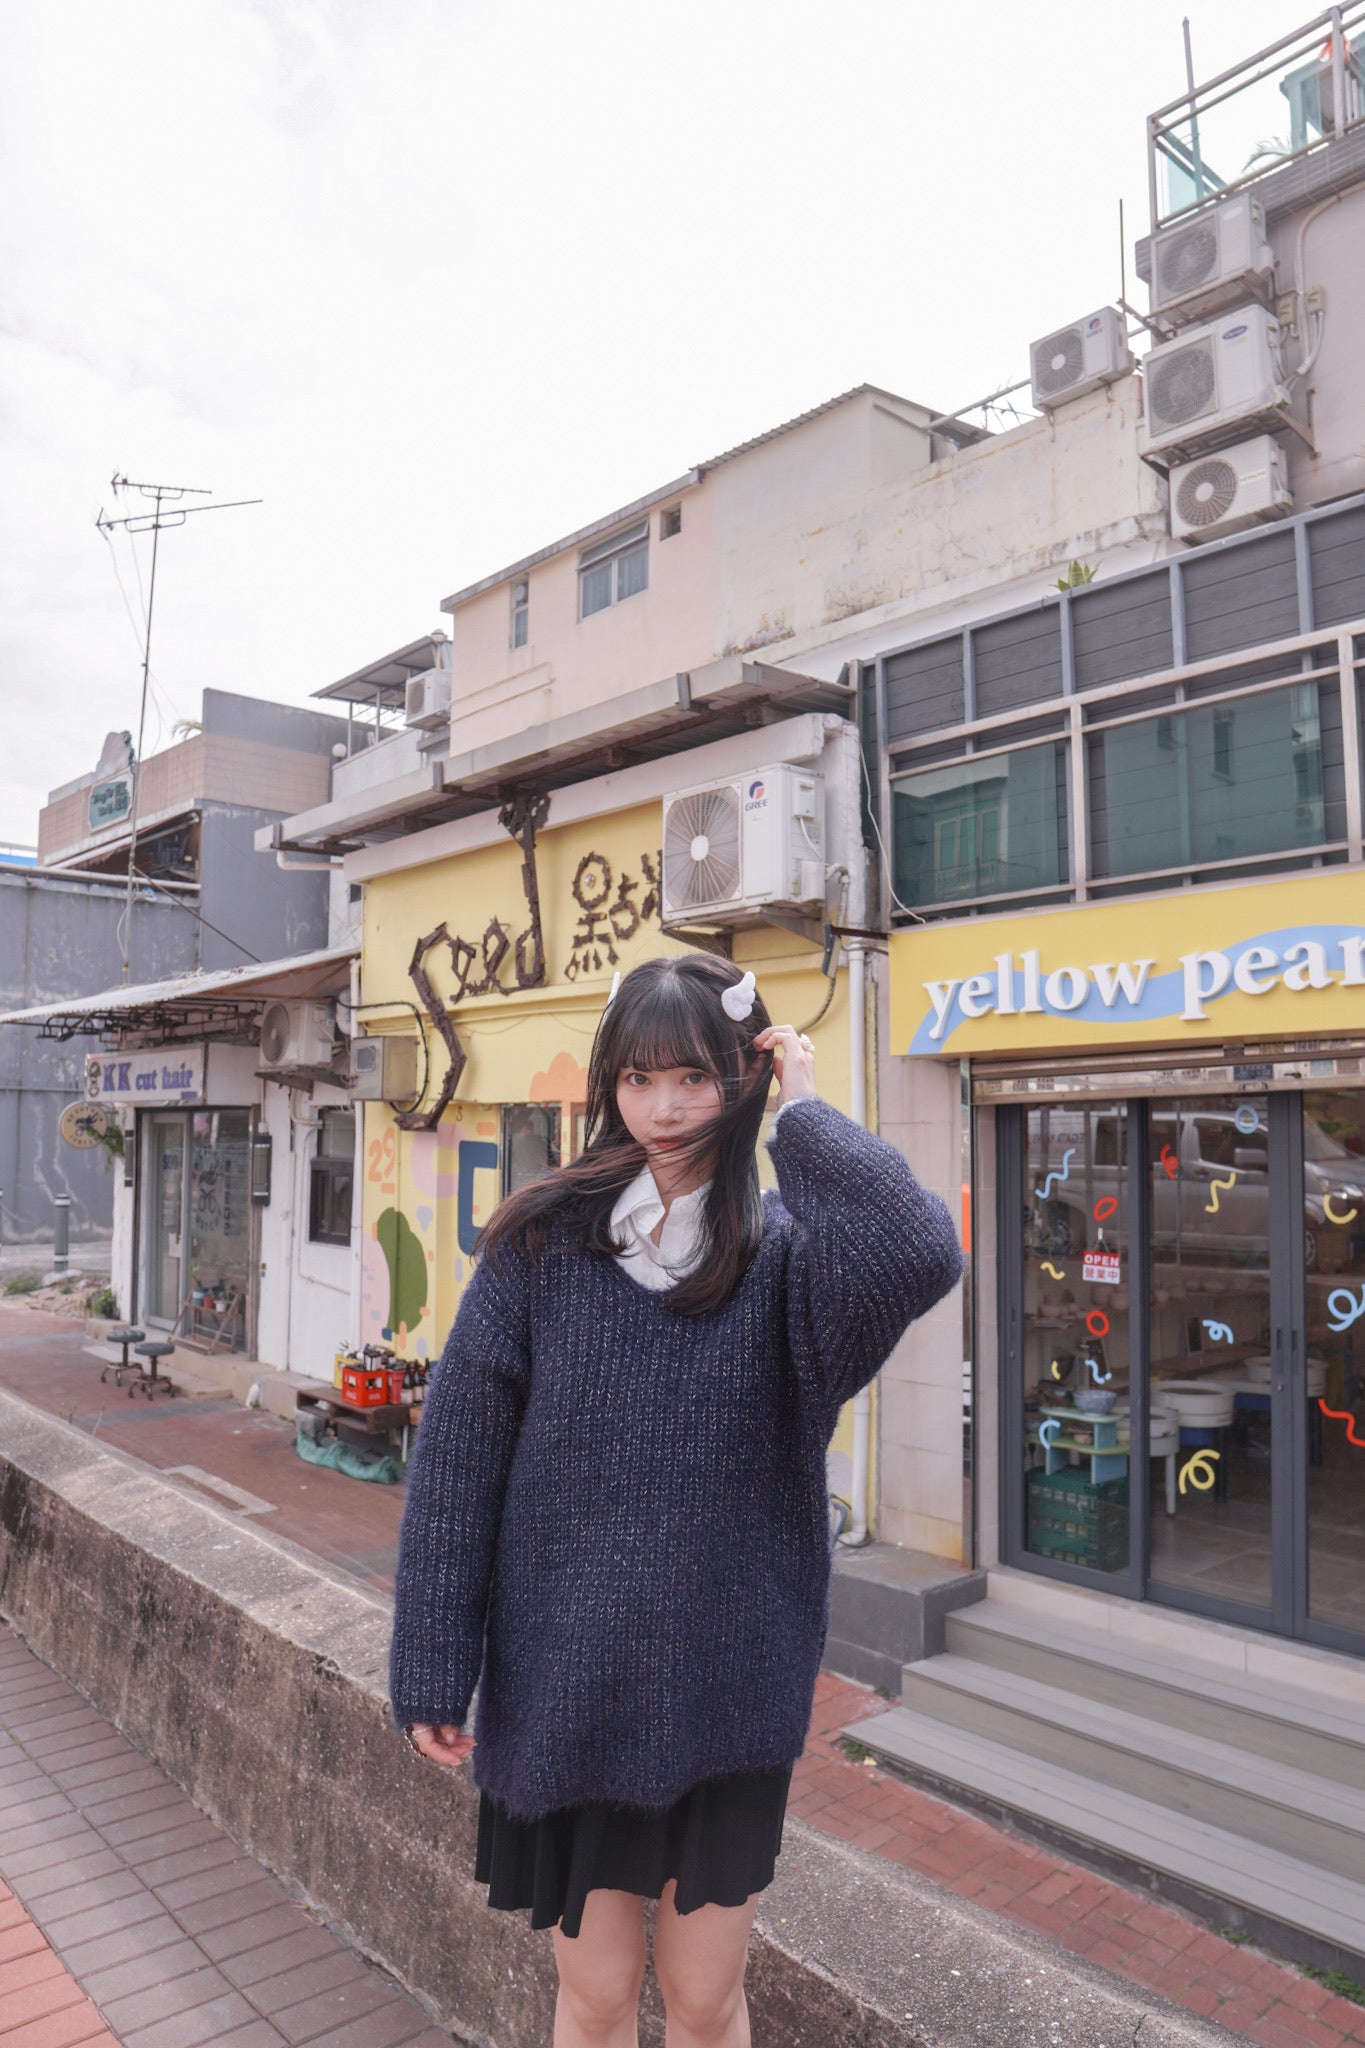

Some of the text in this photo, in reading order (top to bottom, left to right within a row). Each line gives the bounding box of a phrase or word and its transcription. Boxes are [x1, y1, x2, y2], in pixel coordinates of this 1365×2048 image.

[745, 799, 769, 811] GREE
[922, 949, 1157, 1040] yellow
[136, 1069, 157, 1091] cut
[161, 1061, 193, 1090] hair
[367, 1127, 396, 1183] 29
[1084, 1253, 1119, 1266] OPEN
